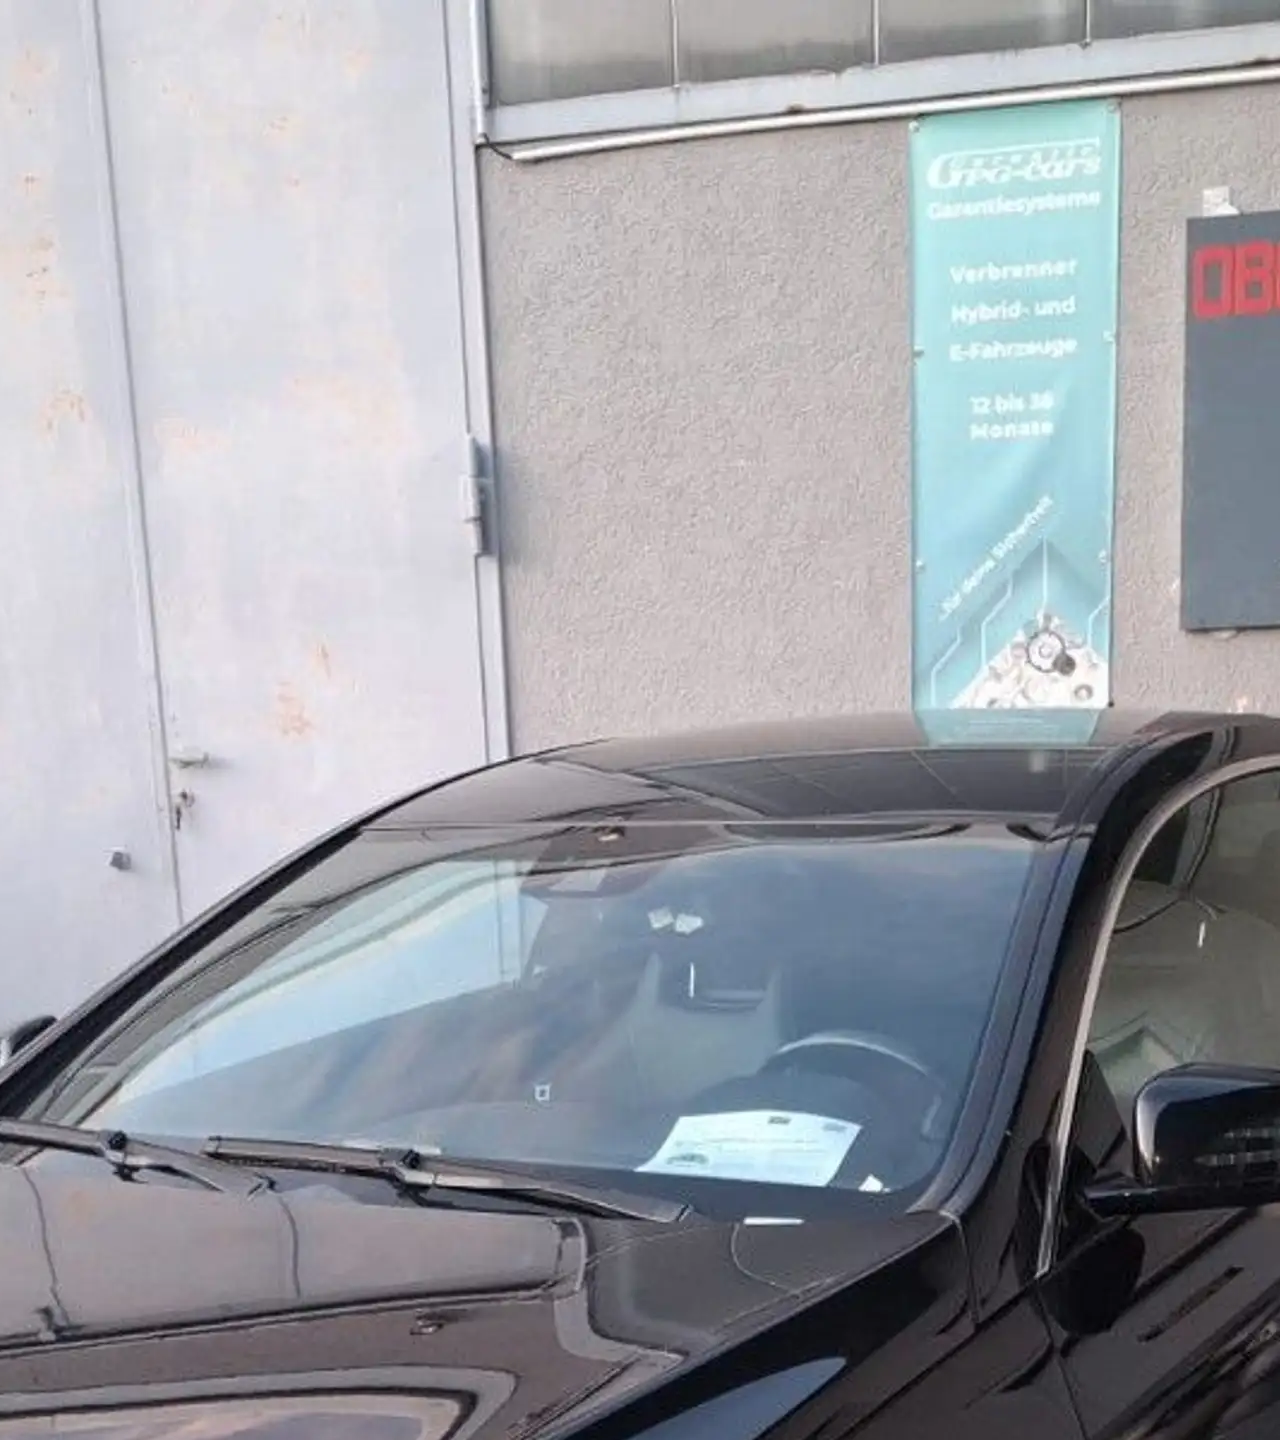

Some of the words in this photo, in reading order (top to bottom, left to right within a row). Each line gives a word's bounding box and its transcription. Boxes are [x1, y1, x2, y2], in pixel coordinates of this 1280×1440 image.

[949, 259, 1078, 284] Verbrenner
[951, 300, 1029, 325] Hybrid-
[1035, 295, 1076, 316] und
[949, 338, 1078, 362] E-Fahrzeuge
